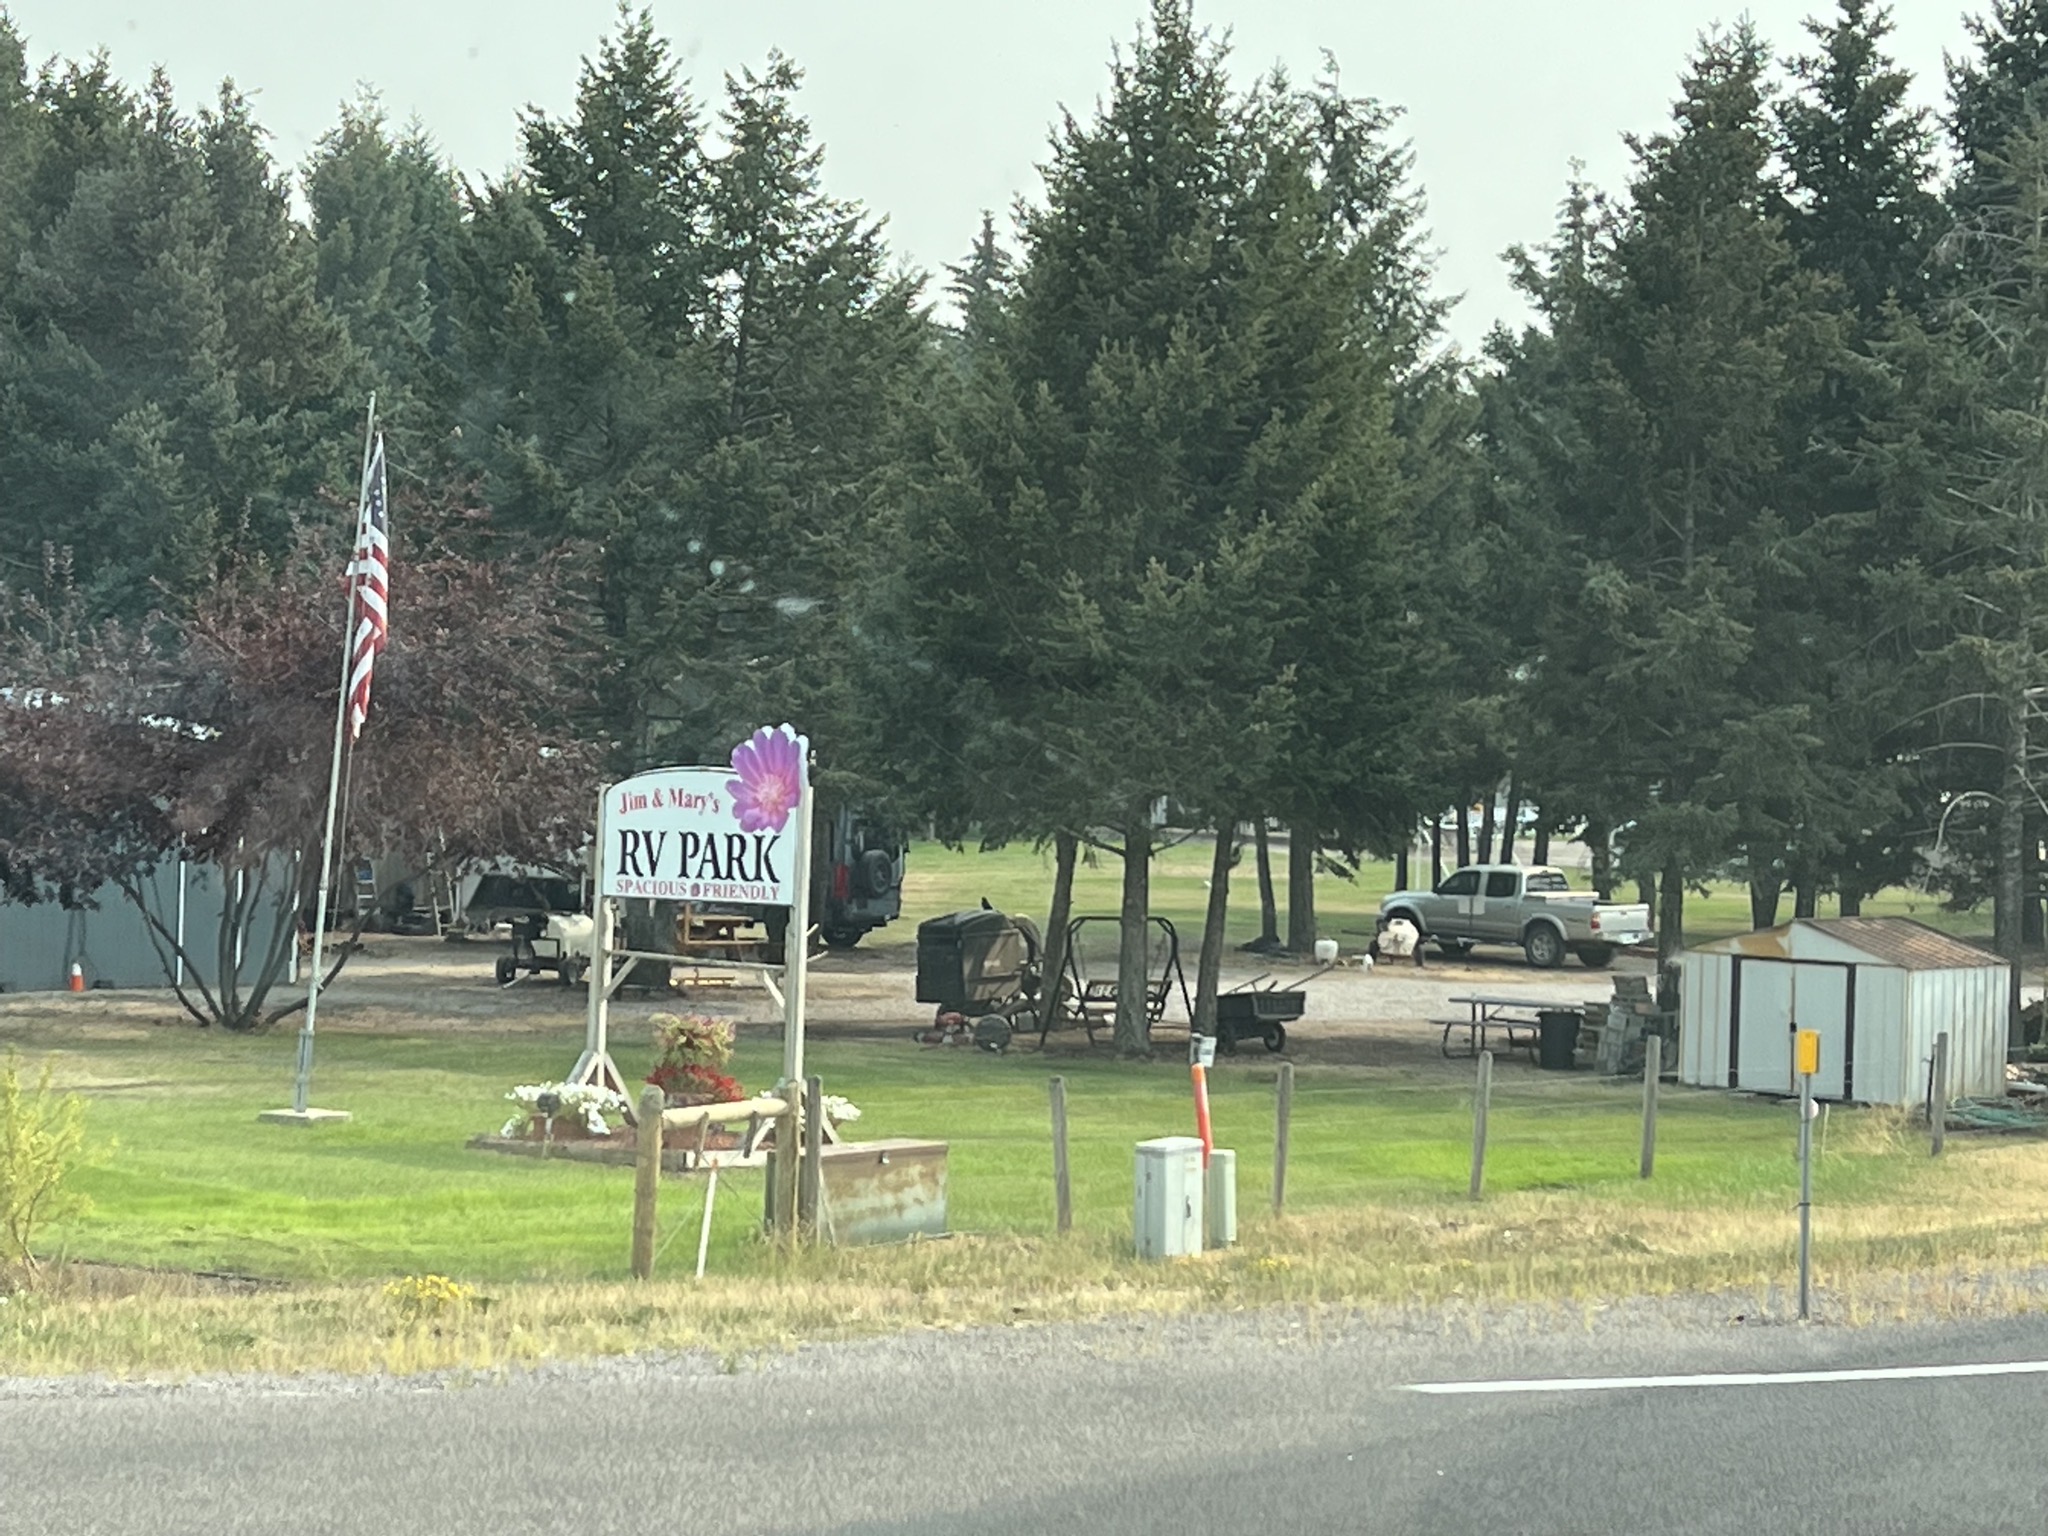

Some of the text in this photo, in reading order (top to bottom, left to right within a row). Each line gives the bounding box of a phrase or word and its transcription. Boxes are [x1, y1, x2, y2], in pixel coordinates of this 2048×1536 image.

[619, 788, 721, 816] Jim & Mary's
[616, 829, 781, 884] RV PARK
[616, 879, 780, 901] SPACIOUS FRIENDLY
